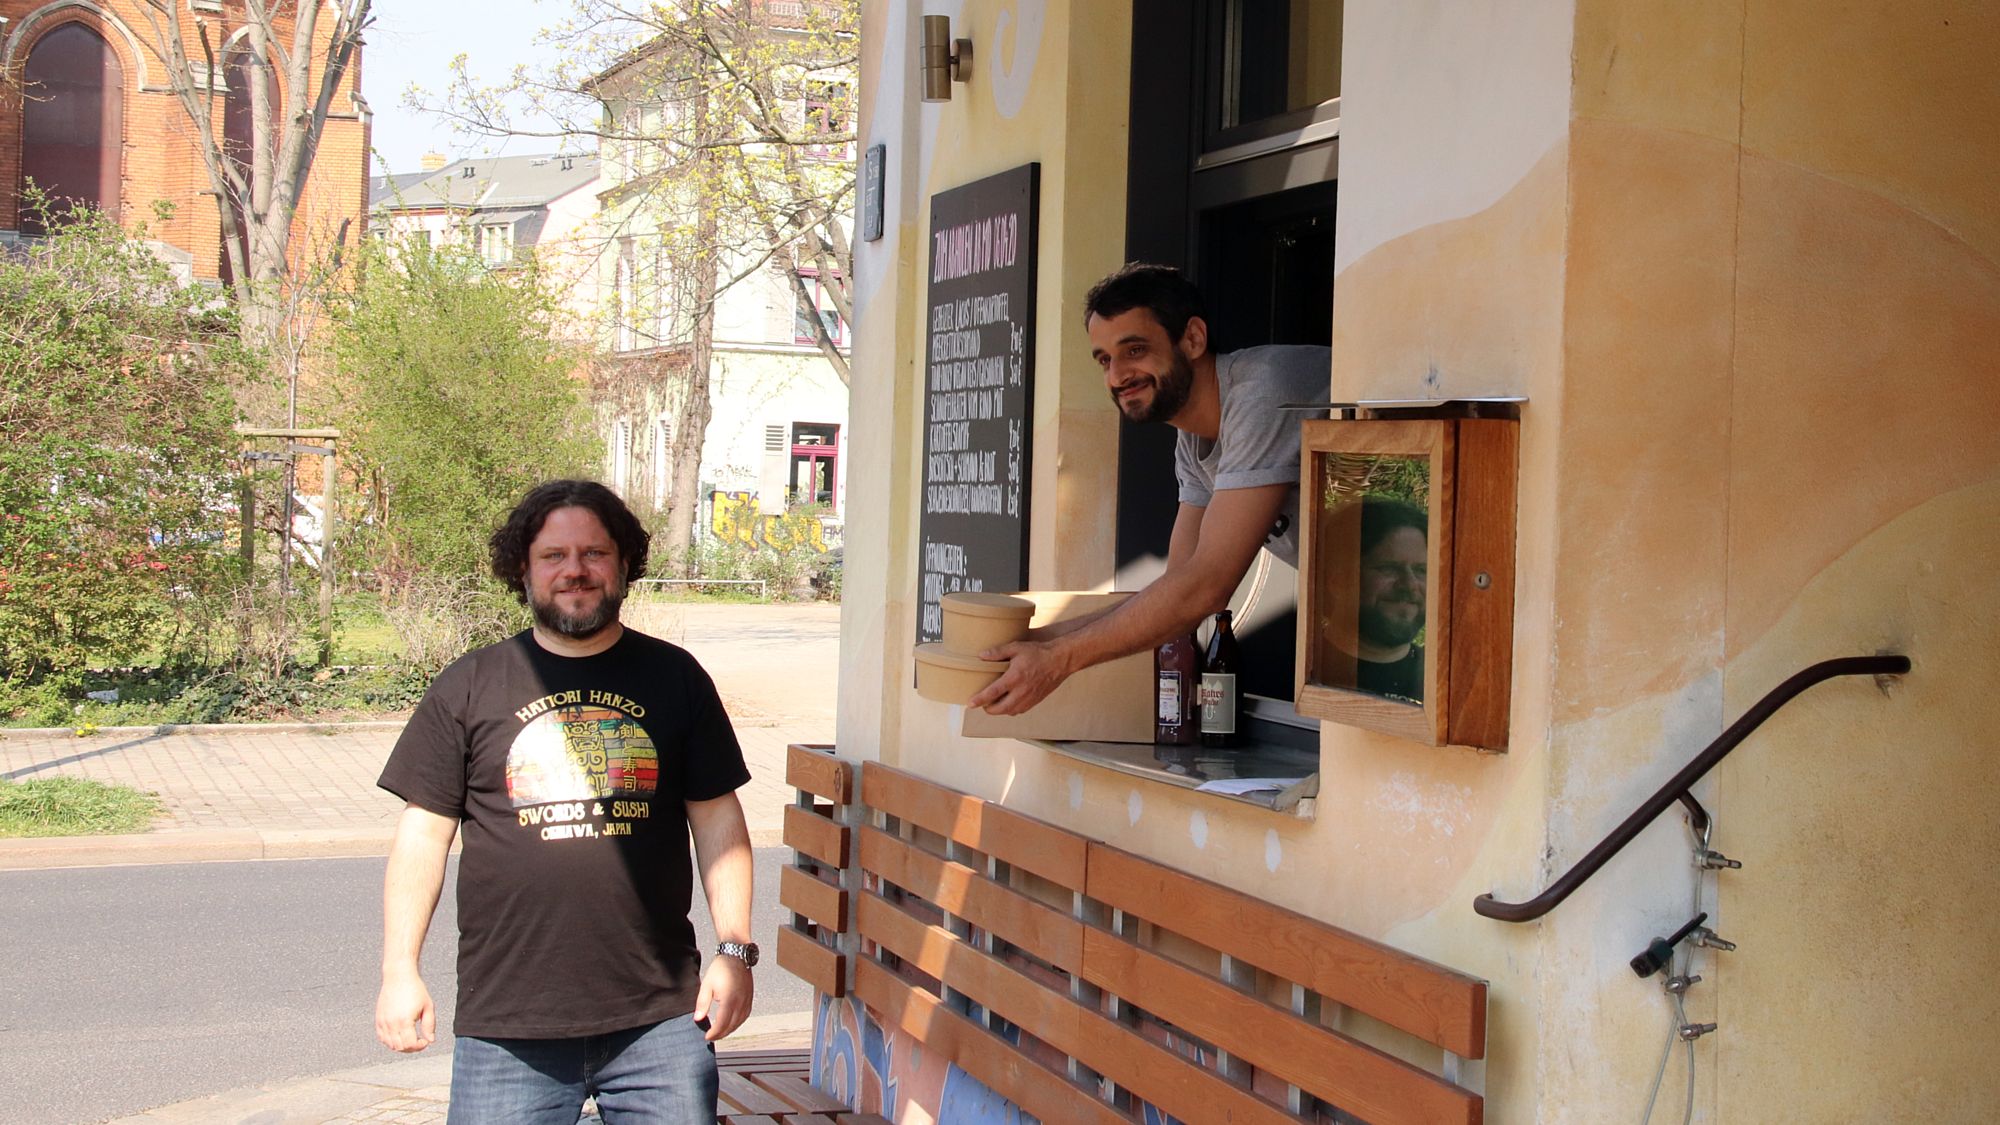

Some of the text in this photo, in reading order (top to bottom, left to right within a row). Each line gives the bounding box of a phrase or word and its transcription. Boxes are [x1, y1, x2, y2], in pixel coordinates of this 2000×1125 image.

[515, 689, 646, 722] HATTORI HANZO
[518, 801, 649, 827] SWORDS & SUSHI
[602, 822, 632, 836] JAPAN
